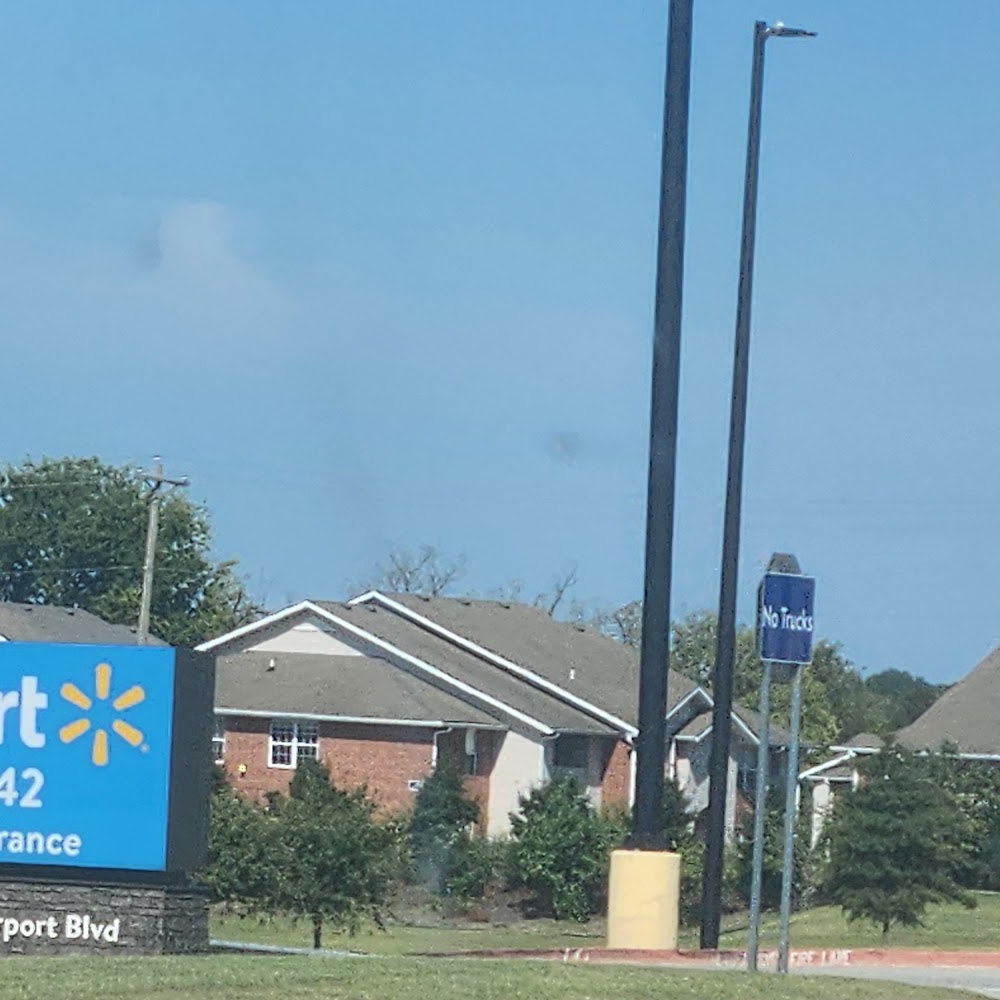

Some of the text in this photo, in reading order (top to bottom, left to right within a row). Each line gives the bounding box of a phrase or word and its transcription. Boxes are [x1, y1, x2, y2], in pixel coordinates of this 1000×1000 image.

[763, 605, 813, 632] No Trucks
[64, 914, 121, 943] Blvd
